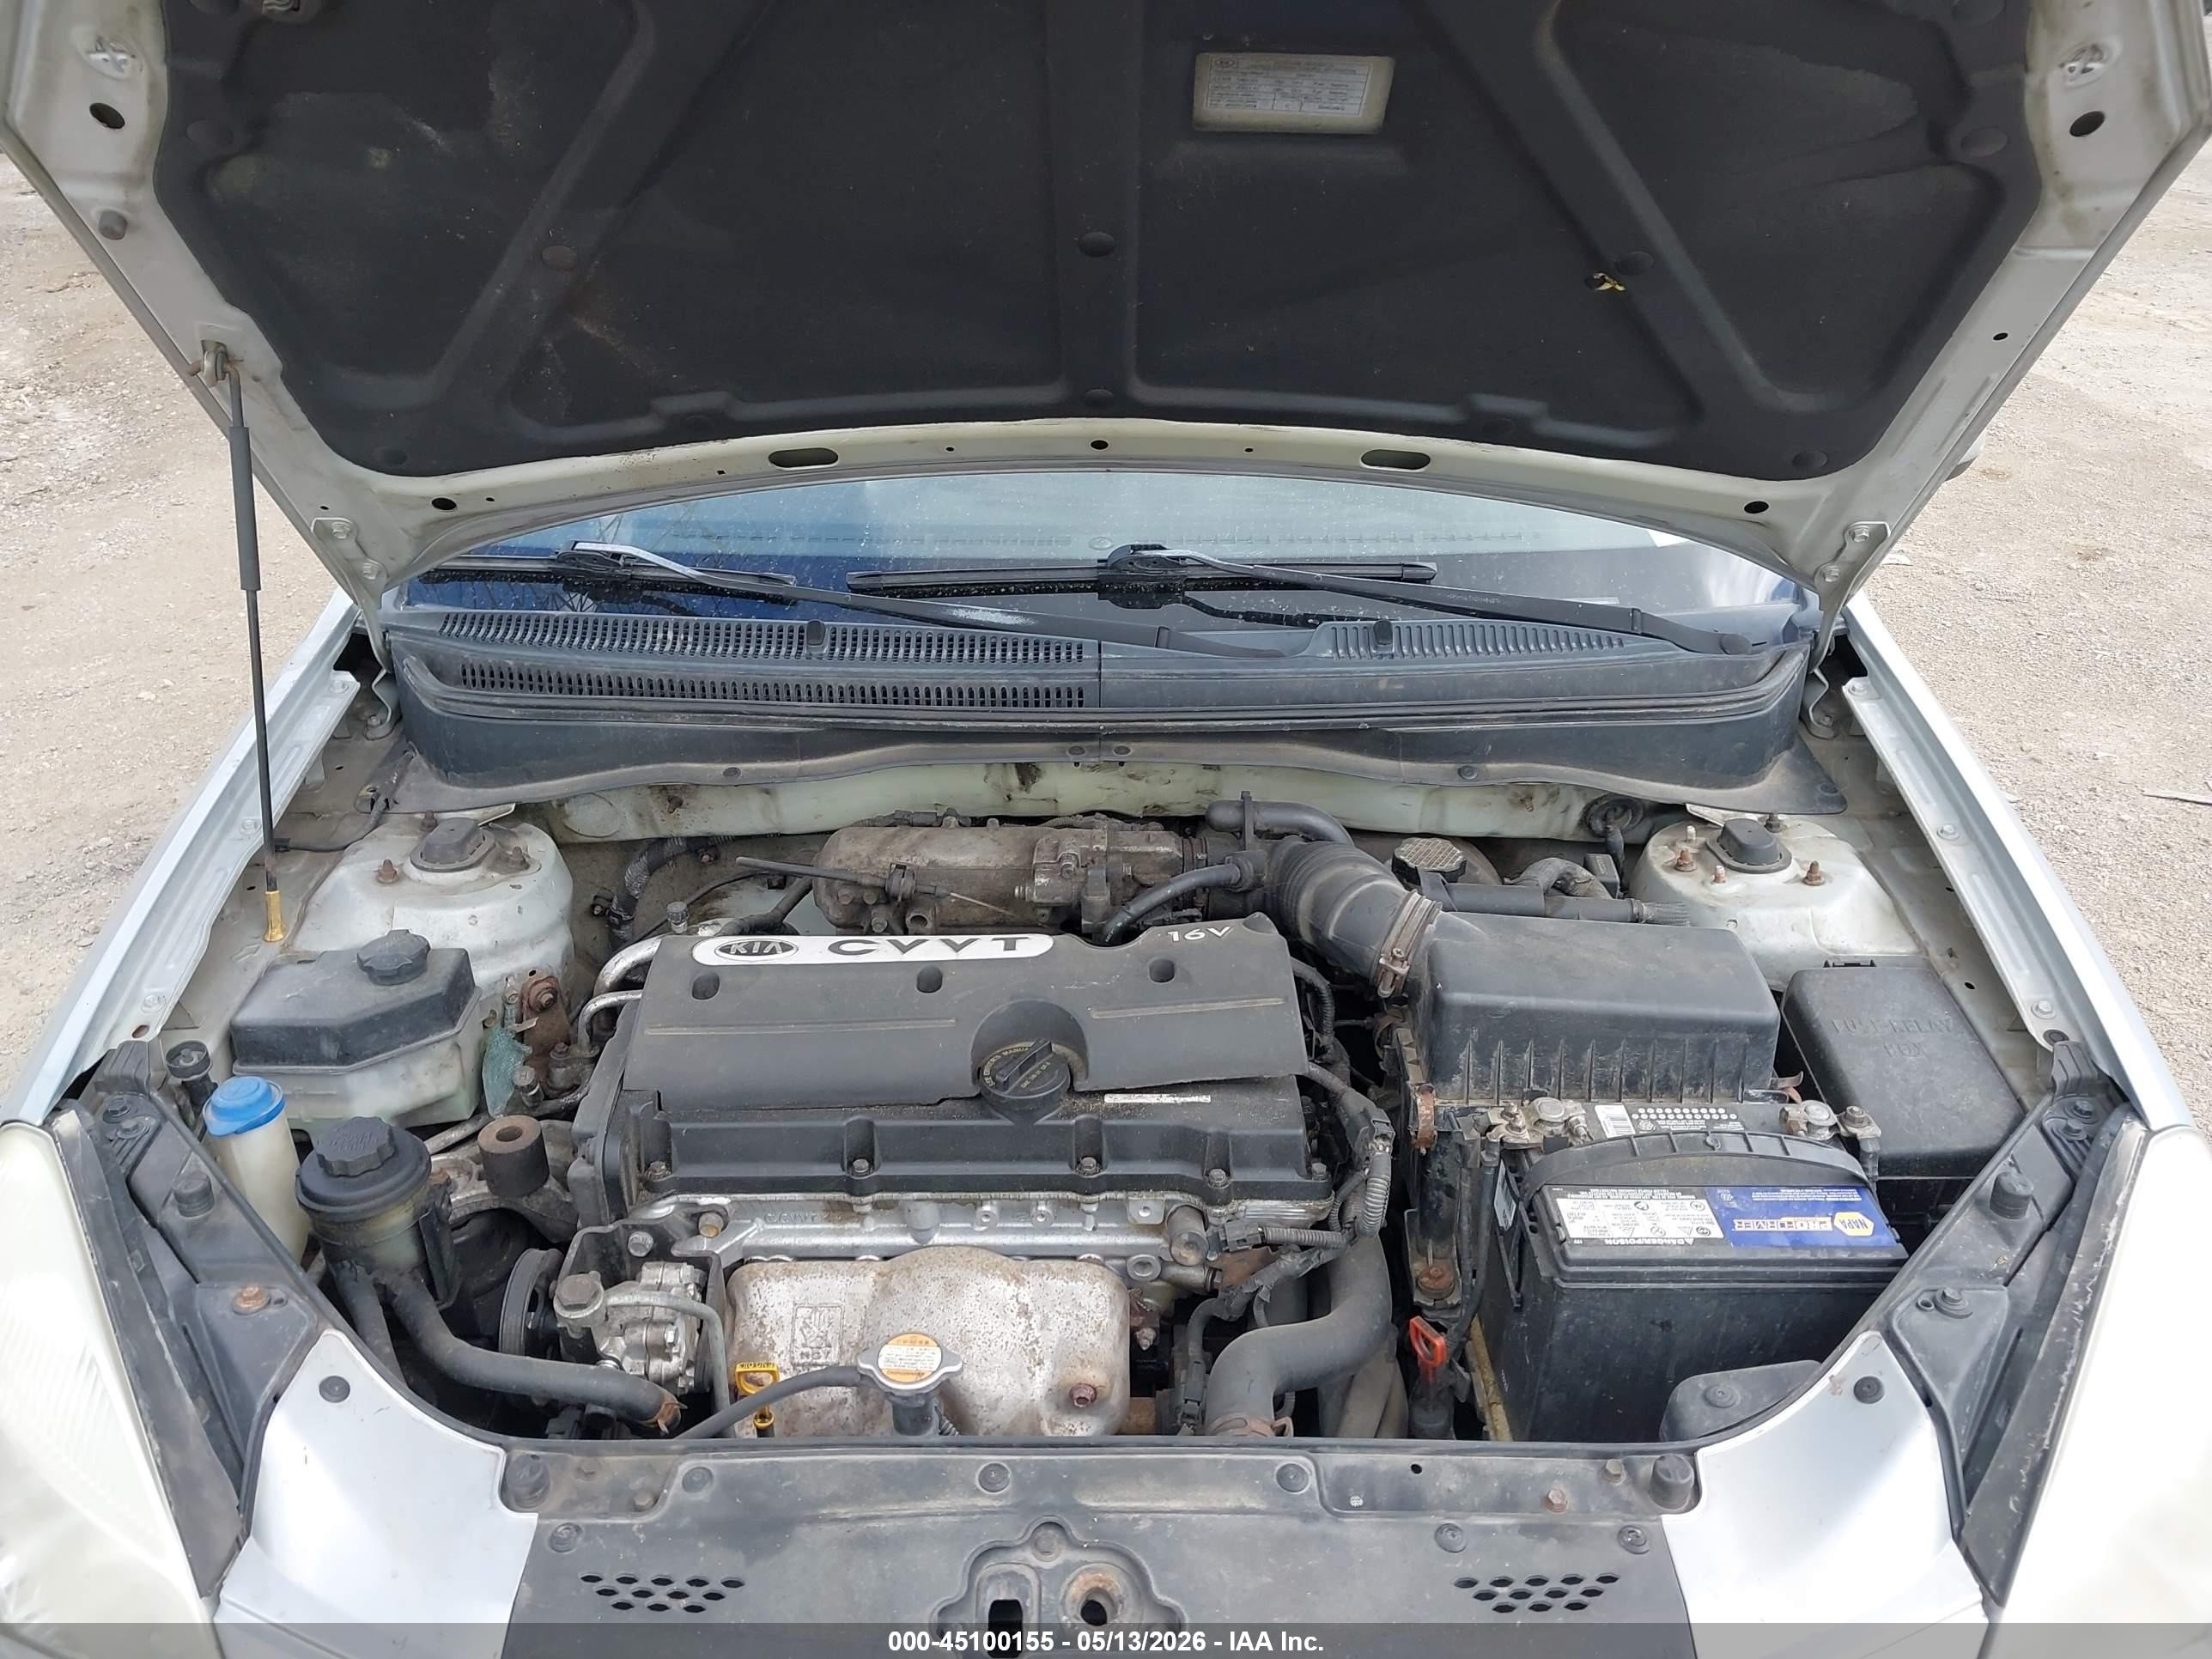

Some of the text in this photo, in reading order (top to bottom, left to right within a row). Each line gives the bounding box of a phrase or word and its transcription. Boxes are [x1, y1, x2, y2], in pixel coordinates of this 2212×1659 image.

[1167, 926, 1231, 942] 16V
[730, 937, 1030, 956] KIA CVVT
[1735, 1218, 1869, 1231] NAPA PROFORMER
